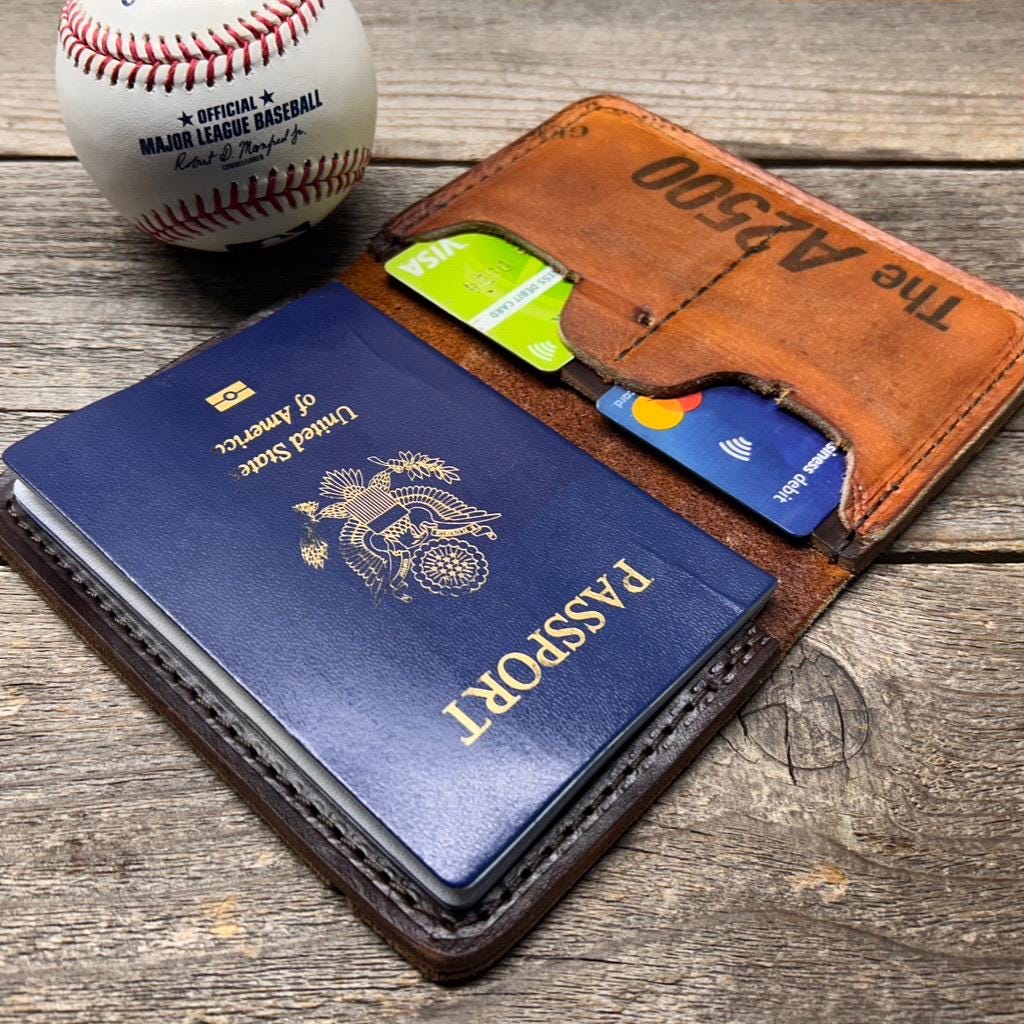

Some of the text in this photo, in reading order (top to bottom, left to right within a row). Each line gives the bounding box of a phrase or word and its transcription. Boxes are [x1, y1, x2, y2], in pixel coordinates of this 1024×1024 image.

[139, 89, 323, 156] MAJOR LEAGUE BASEBALL
[197, 96, 258, 124] OFFICIAL
[398, 238, 469, 278] VISA
[630, 155, 964, 332] The A2500
[294, 393, 316, 417] of
[229, 405, 359, 481] United State
[772, 473, 808, 503] debit
[442, 558, 654, 746] PASSPORT
